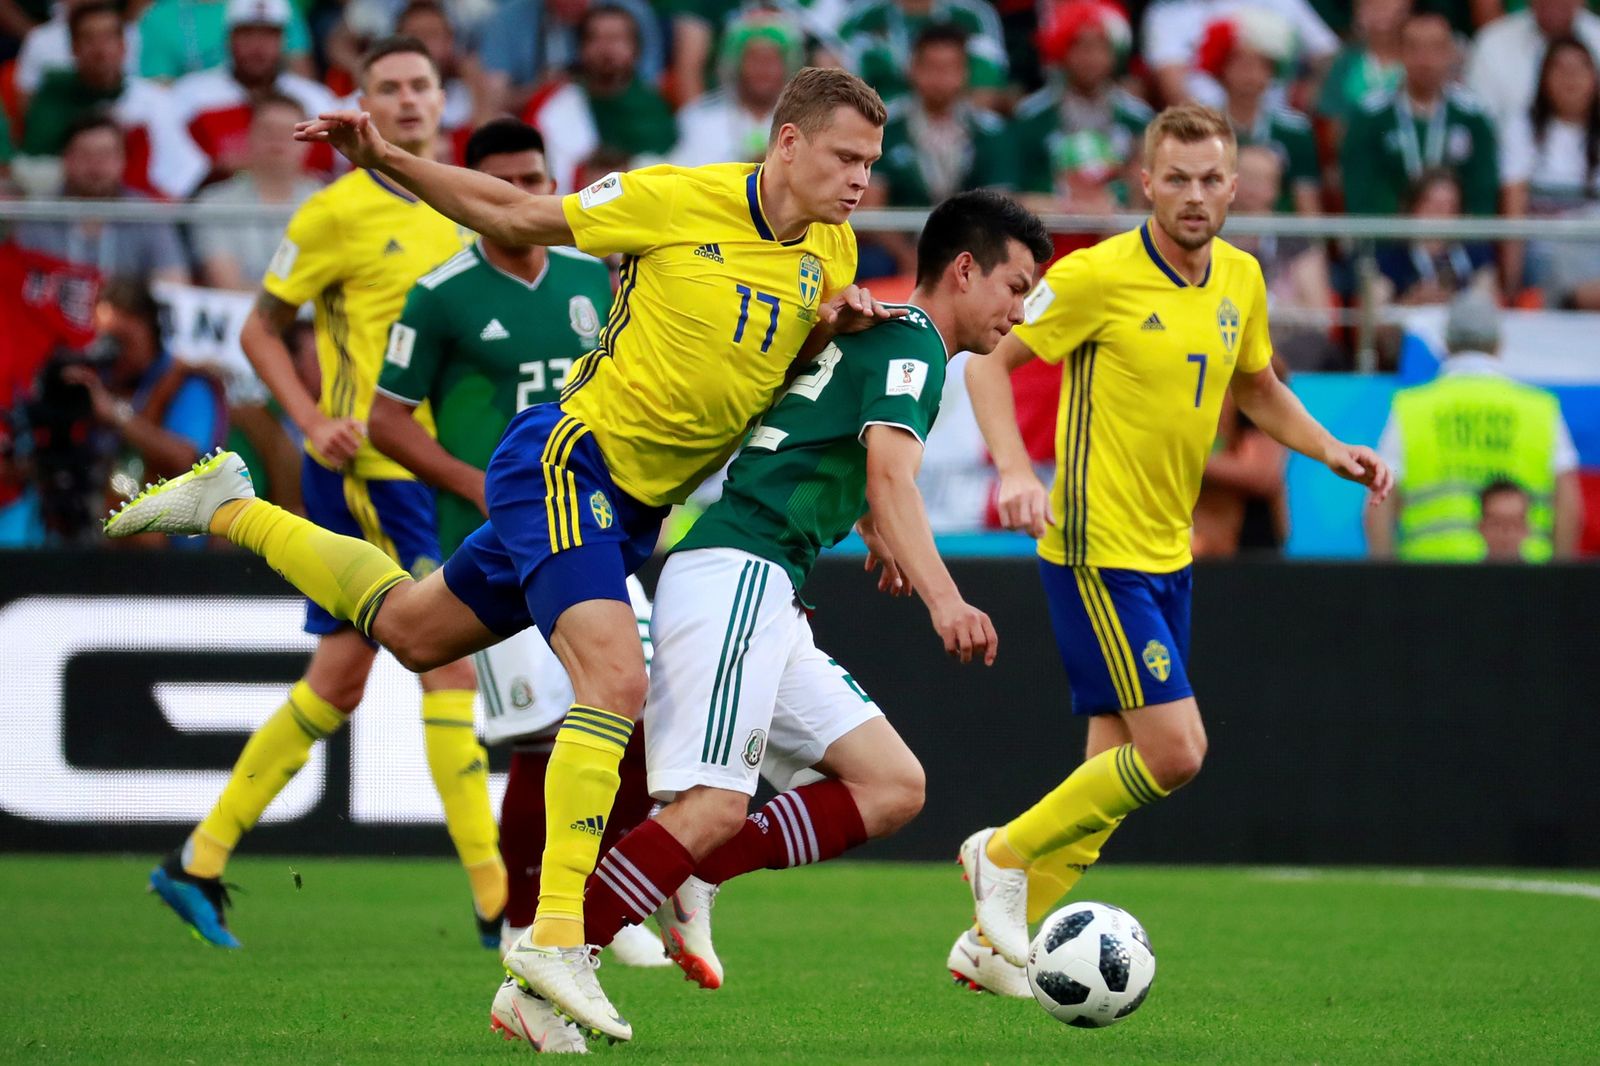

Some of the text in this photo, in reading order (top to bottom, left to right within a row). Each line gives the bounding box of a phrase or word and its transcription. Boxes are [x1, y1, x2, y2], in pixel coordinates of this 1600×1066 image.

[694, 248, 725, 265] adidas
[733, 283, 781, 353] 17
[1187, 354, 1207, 408] 7
[570, 822, 603, 837] adida
